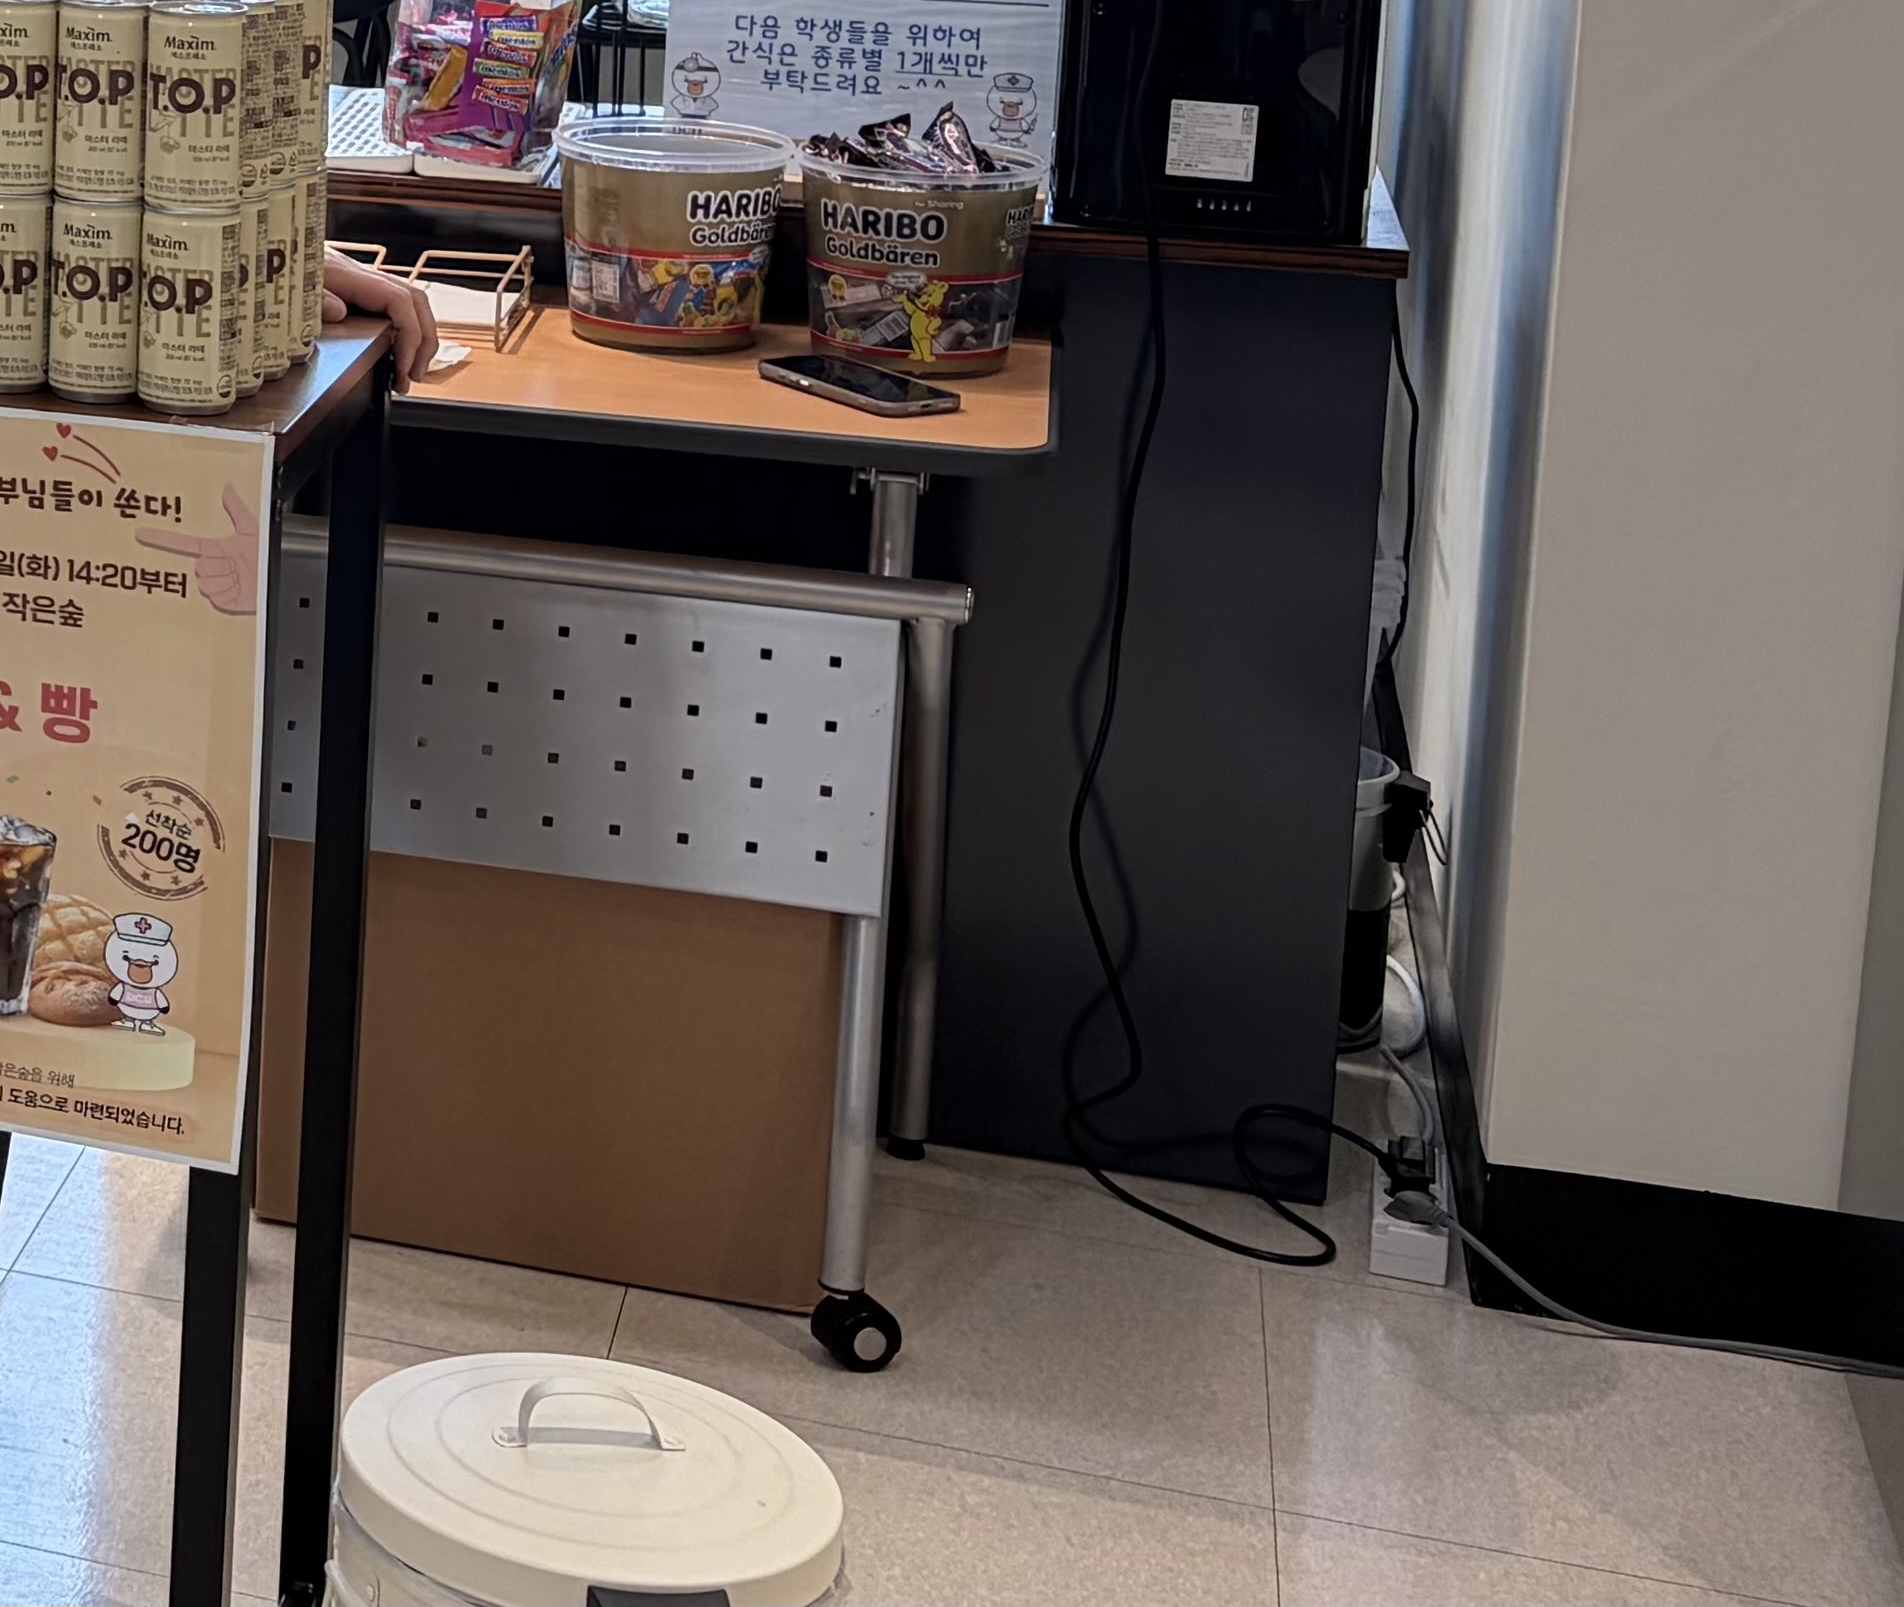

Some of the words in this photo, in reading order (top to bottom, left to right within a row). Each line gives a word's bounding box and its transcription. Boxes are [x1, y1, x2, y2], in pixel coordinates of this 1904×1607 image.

[64, 25, 113, 44] Maxim
[163, 34, 217, 52] Maxim
[734, 14, 782, 41] 다음
[794, 16, 893, 47] 학생들을
[905, 23, 982, 51] 위하여
[726, 39, 799, 68] 간식은
[812, 44, 884, 74] 종류별
[895, 50, 989, 79] 1개씩만
[760, 68, 883, 97] 부탁드려요
[63, 222, 113, 242] Maxim
[821, 198, 947, 243] HARIBO
[825, 235, 940, 268] Goldbären
[113, 486, 183, 524] 쏜다!
[66, 558, 188, 599] 14:20부터
[40, 681, 99, 745] 빵
[121, 822, 202, 875] 200명
[6, 1087, 70, 1115] 도움으로
